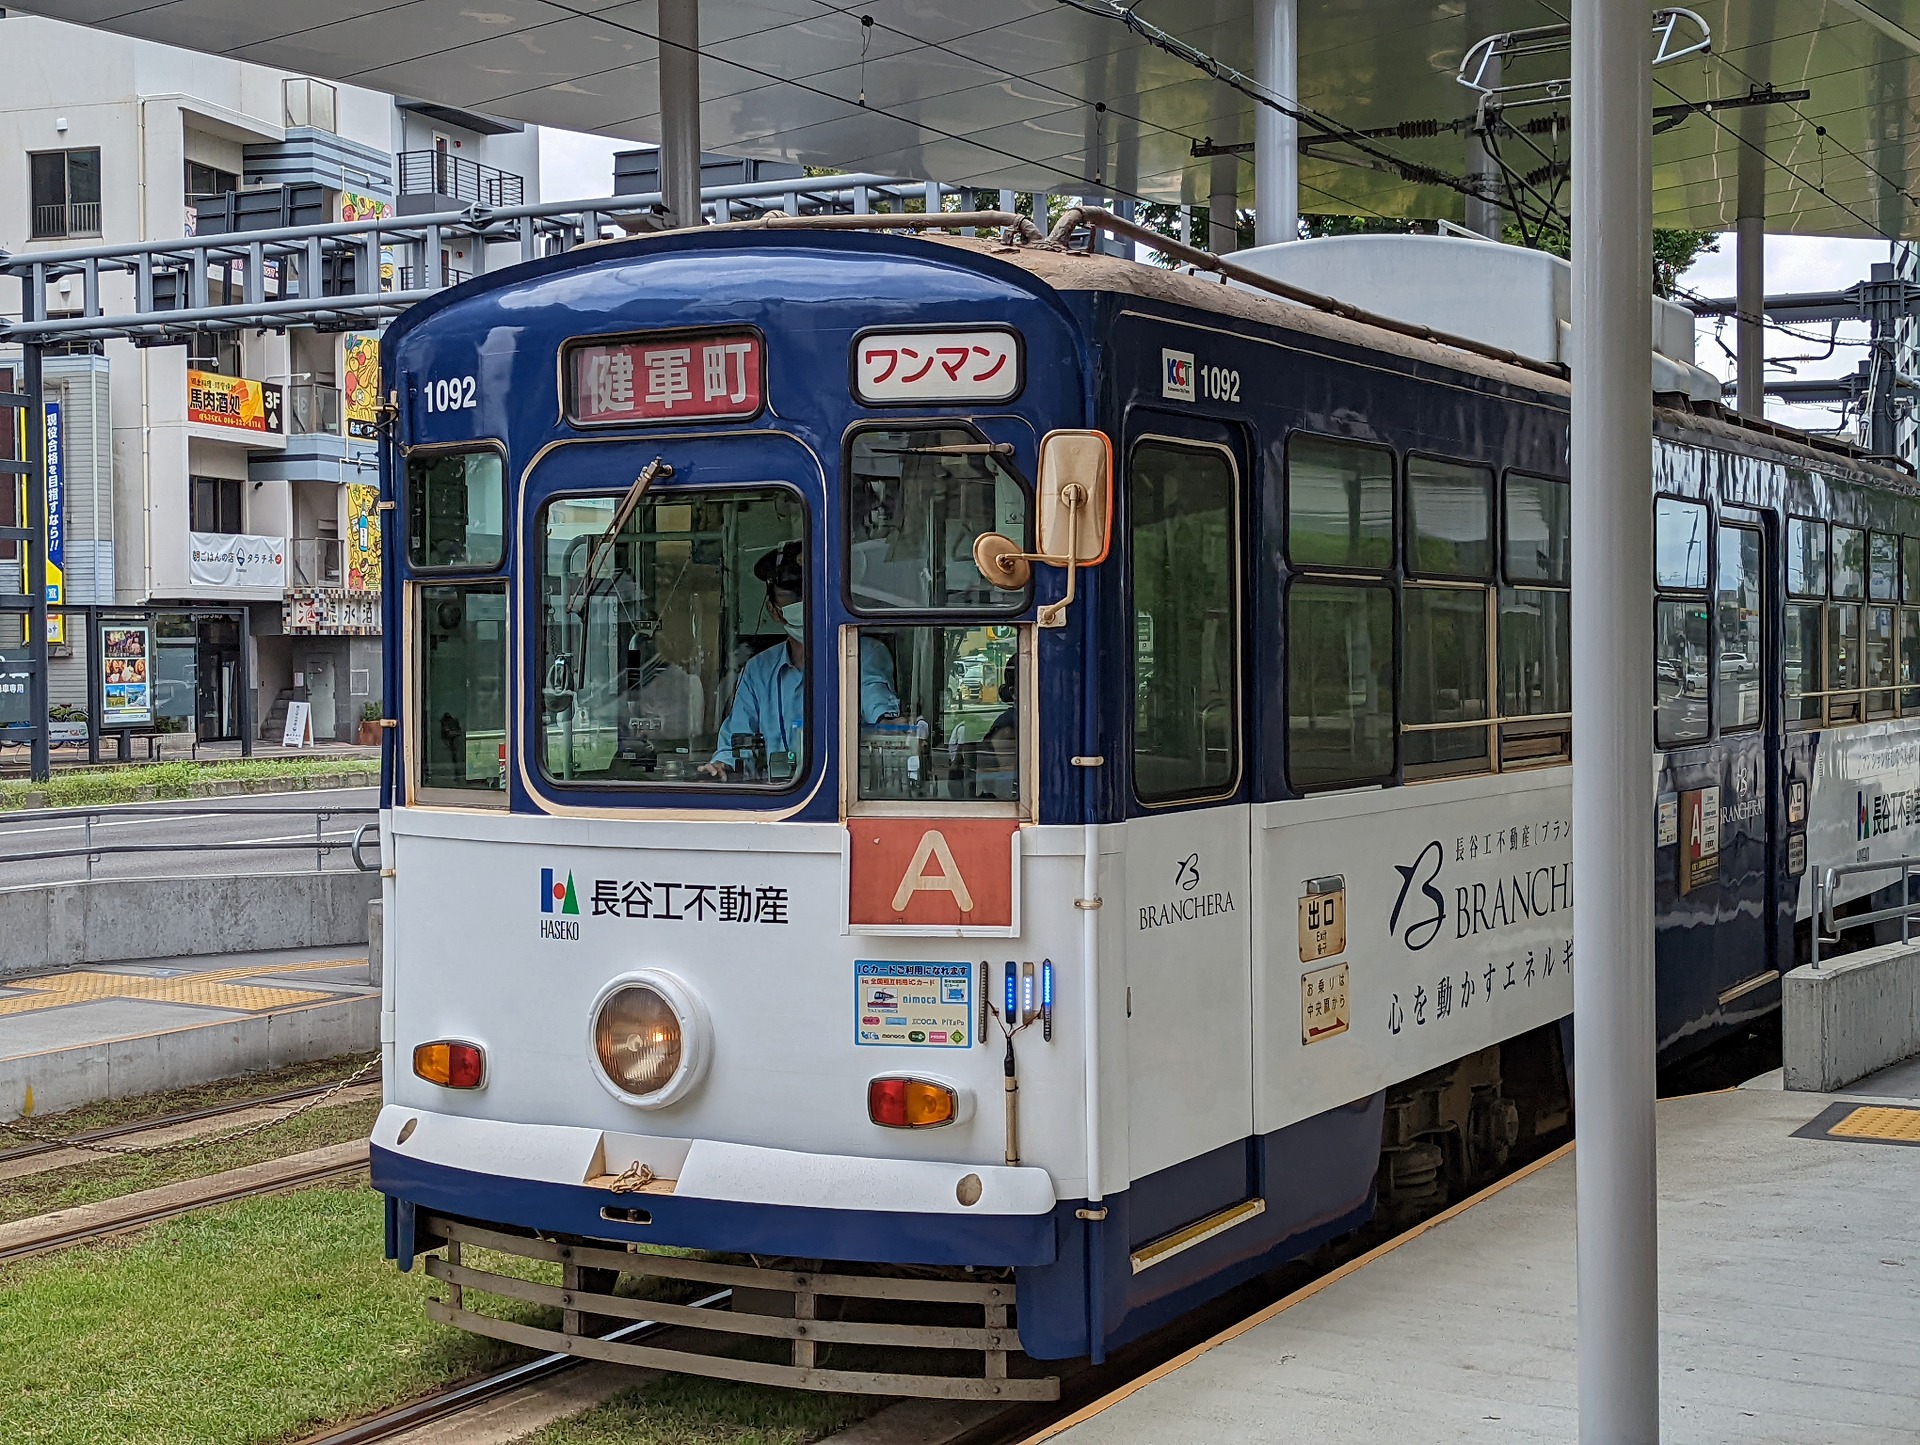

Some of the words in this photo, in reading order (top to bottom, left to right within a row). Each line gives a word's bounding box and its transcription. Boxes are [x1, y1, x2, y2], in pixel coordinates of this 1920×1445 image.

[585, 342, 752, 415] 健軍町
[865, 346, 1007, 383] ワンマン
[1167, 358, 1192, 387] KCT
[1201, 364, 1240, 403] 1092
[190, 388, 241, 415] 馬肉酒処
[265, 390, 281, 410] 3F
[424, 376, 477, 413] 1092
[892, 829, 973, 912] A
[590, 879, 789, 925] 長谷工不動産
[1139, 891, 1236, 931] BRANCHERA
[1309, 899, 1334, 930] 出口
[1455, 862, 1573, 940] BRANCH
[540, 919, 579, 941] HASEKO
[1317, 930, 1327, 942] Exit
[857, 964, 968, 976] ICカードご利用になれます
[1306, 974, 1345, 997] お乗りは
[1388, 936, 1573, 1035] 心を動かすエネルギ
[902, 994, 937, 1005] nimoca
